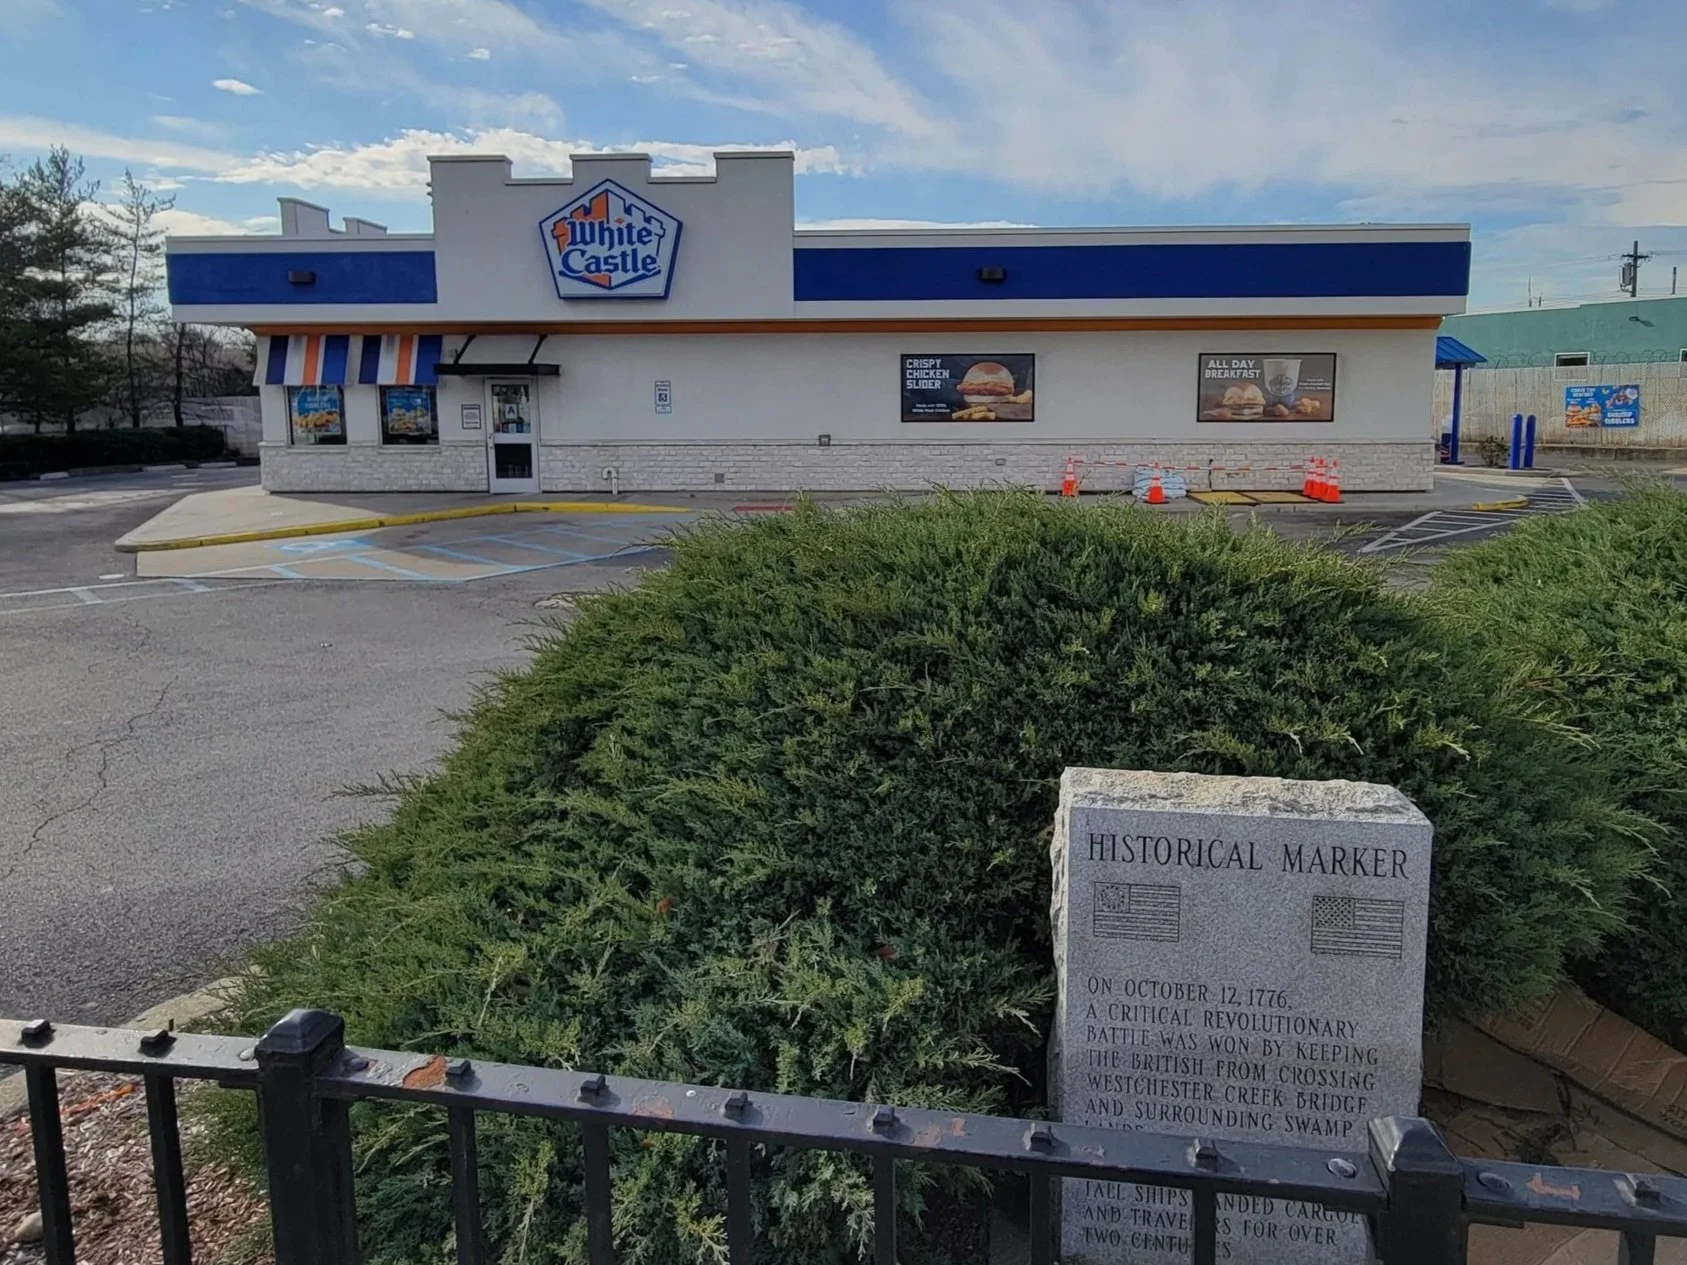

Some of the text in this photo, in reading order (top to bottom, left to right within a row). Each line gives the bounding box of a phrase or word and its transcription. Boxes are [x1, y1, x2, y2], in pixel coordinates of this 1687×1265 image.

[567, 217, 653, 251] White
[561, 247, 658, 274] Castle
[906, 359, 942, 369] CRISPY
[906, 369, 950, 379] CHICKEN
[1204, 369, 1261, 379] BREAKFAST
[1208, 359, 1255, 369] ALL DAY
[906, 380, 941, 389] SLIDER
[507, 405, 516, 415] A
[1088, 833, 1409, 879] HISTORICAL MARKER
[1087, 976, 1112, 995] ON
[1124, 979, 1208, 1003] OCTOBER
[1085, 1003, 1359, 1039] A CRITICAL REVOLUTIONARY
[1087, 1024, 1378, 1066] BATTLE WAS WON BY KEEPING
[1086, 1049, 1375, 1091] THE BRITISH FROM CROSSING
[1087, 1073, 1367, 1116] WESTCHESTER CREEK BRIDGE
[1085, 1098, 1125, 1117] AND
[1135, 1101, 1274, 1131] SURROUNDING
[1284, 1115, 1353, 1138] SWAMP
[1082, 1180, 1124, 1201] TALL
[1134, 1185, 1189, 1207] SHIPS
[1084, 1204, 1338, 1247] AND TRAVES FOR OVER
[1082, 1226, 1232, 1260] TWO CENTUS
